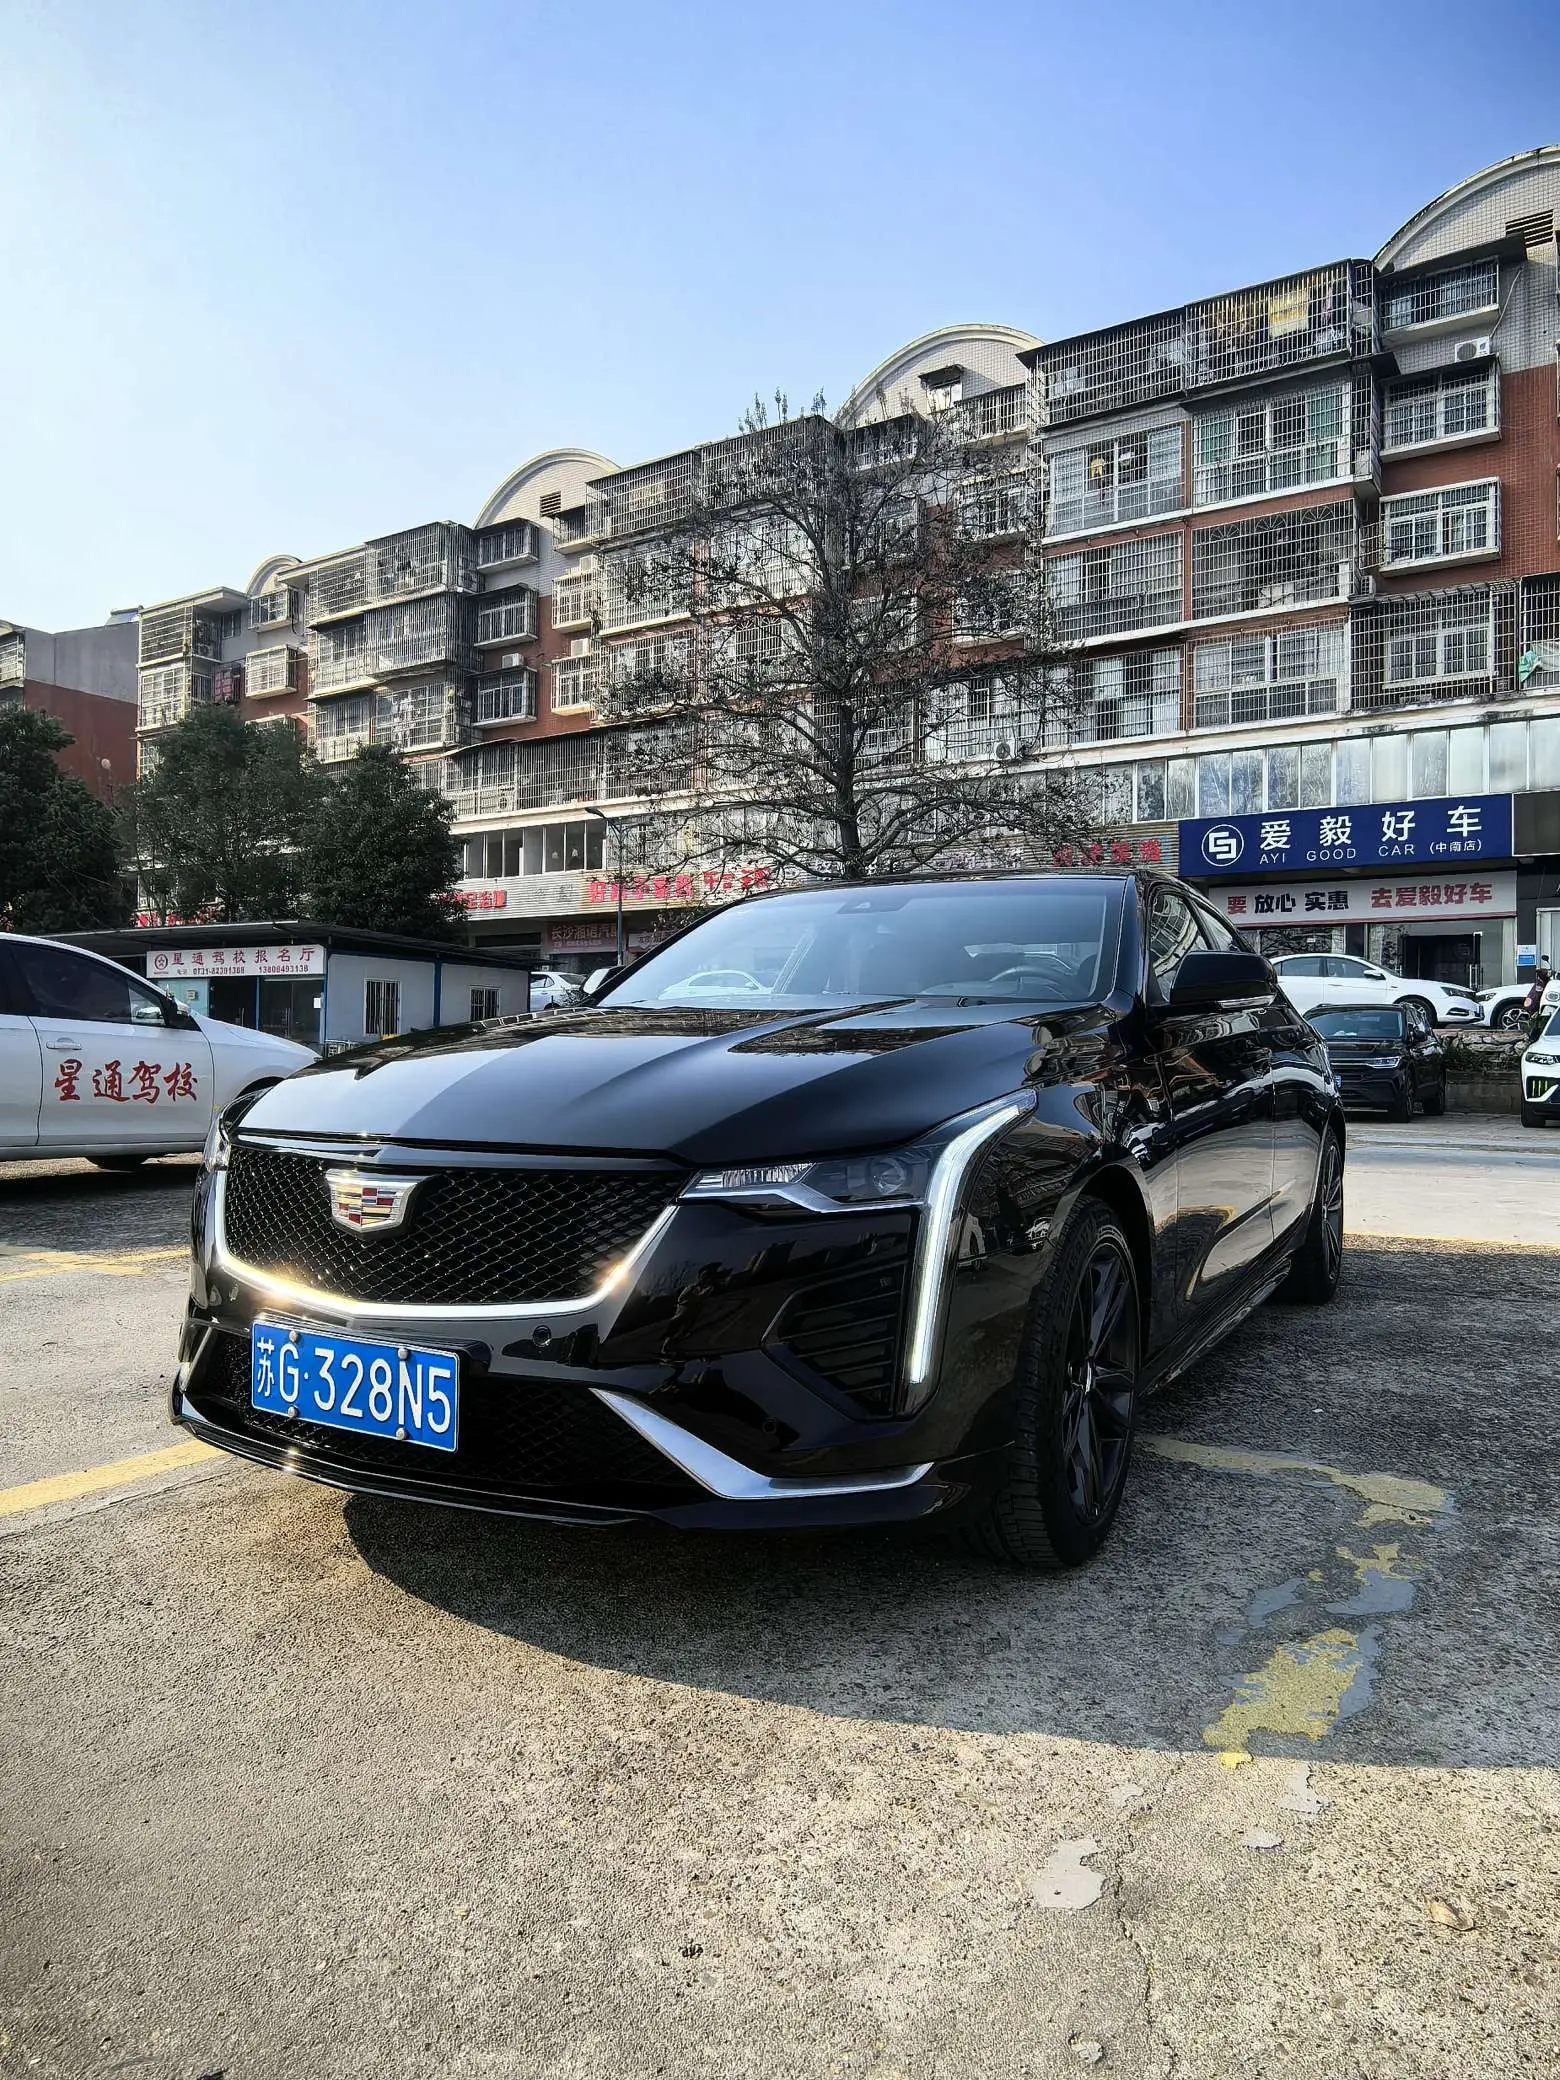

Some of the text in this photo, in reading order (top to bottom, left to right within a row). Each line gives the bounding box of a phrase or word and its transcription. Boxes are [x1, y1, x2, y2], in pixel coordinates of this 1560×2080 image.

[1260, 805, 1483, 850] 爱毅好车
[1259, 843, 1416, 864] AYI GOOD CAR
[1227, 883, 1493, 915] 要 放心 实惠 去爱毅好车
[171, 947, 316, 966] 星通驾校报名厅
[54, 1058, 198, 1104] 星通驾校
